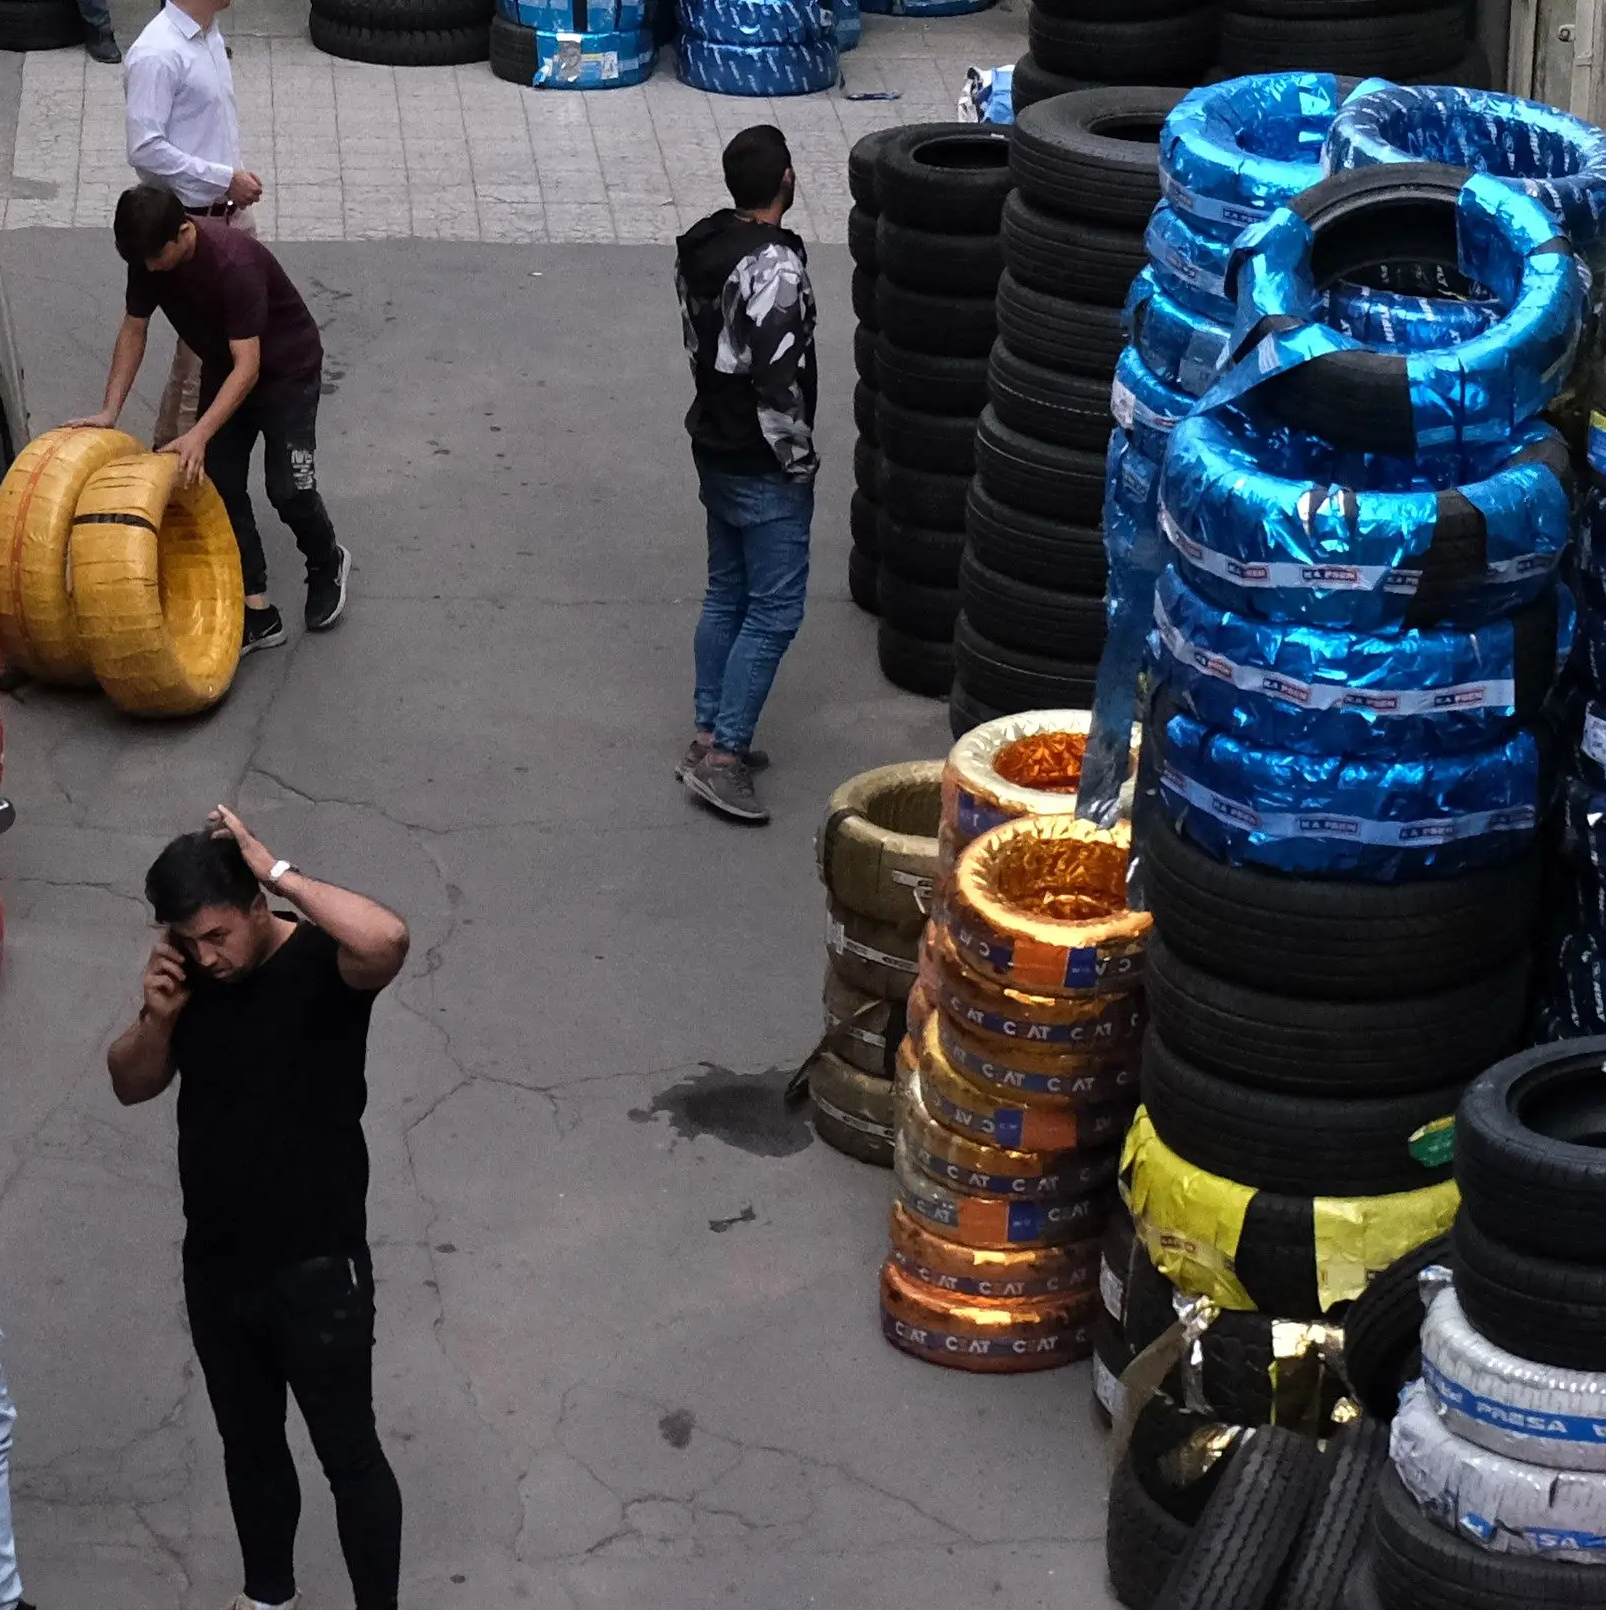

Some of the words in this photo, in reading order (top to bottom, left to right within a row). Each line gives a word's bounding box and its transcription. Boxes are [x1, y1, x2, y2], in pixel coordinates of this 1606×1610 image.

[950, 997, 985, 1025] CAT
[1002, 1020, 1052, 1041] CAT
[1070, 1021, 1113, 1041] CAT
[981, 1063, 1027, 1087] CAT
[1046, 1076, 1096, 1093] CAT
[946, 1164, 991, 1189] CAT
[1011, 1175, 1060, 1193] CAT
[916, 1199, 951, 1224] CAT
[1047, 1200, 1090, 1223] CAT
[918, 1266, 959, 1290] CAT
[978, 1281, 1026, 1297] CAT
[1046, 1267, 1087, 1291] CAT
[894, 1320, 929, 1345] CAT
[945, 1335, 992, 1354] CAT
[1012, 1335, 1059, 1354] CAT
[1475, 1401, 1568, 1435] PRESA
